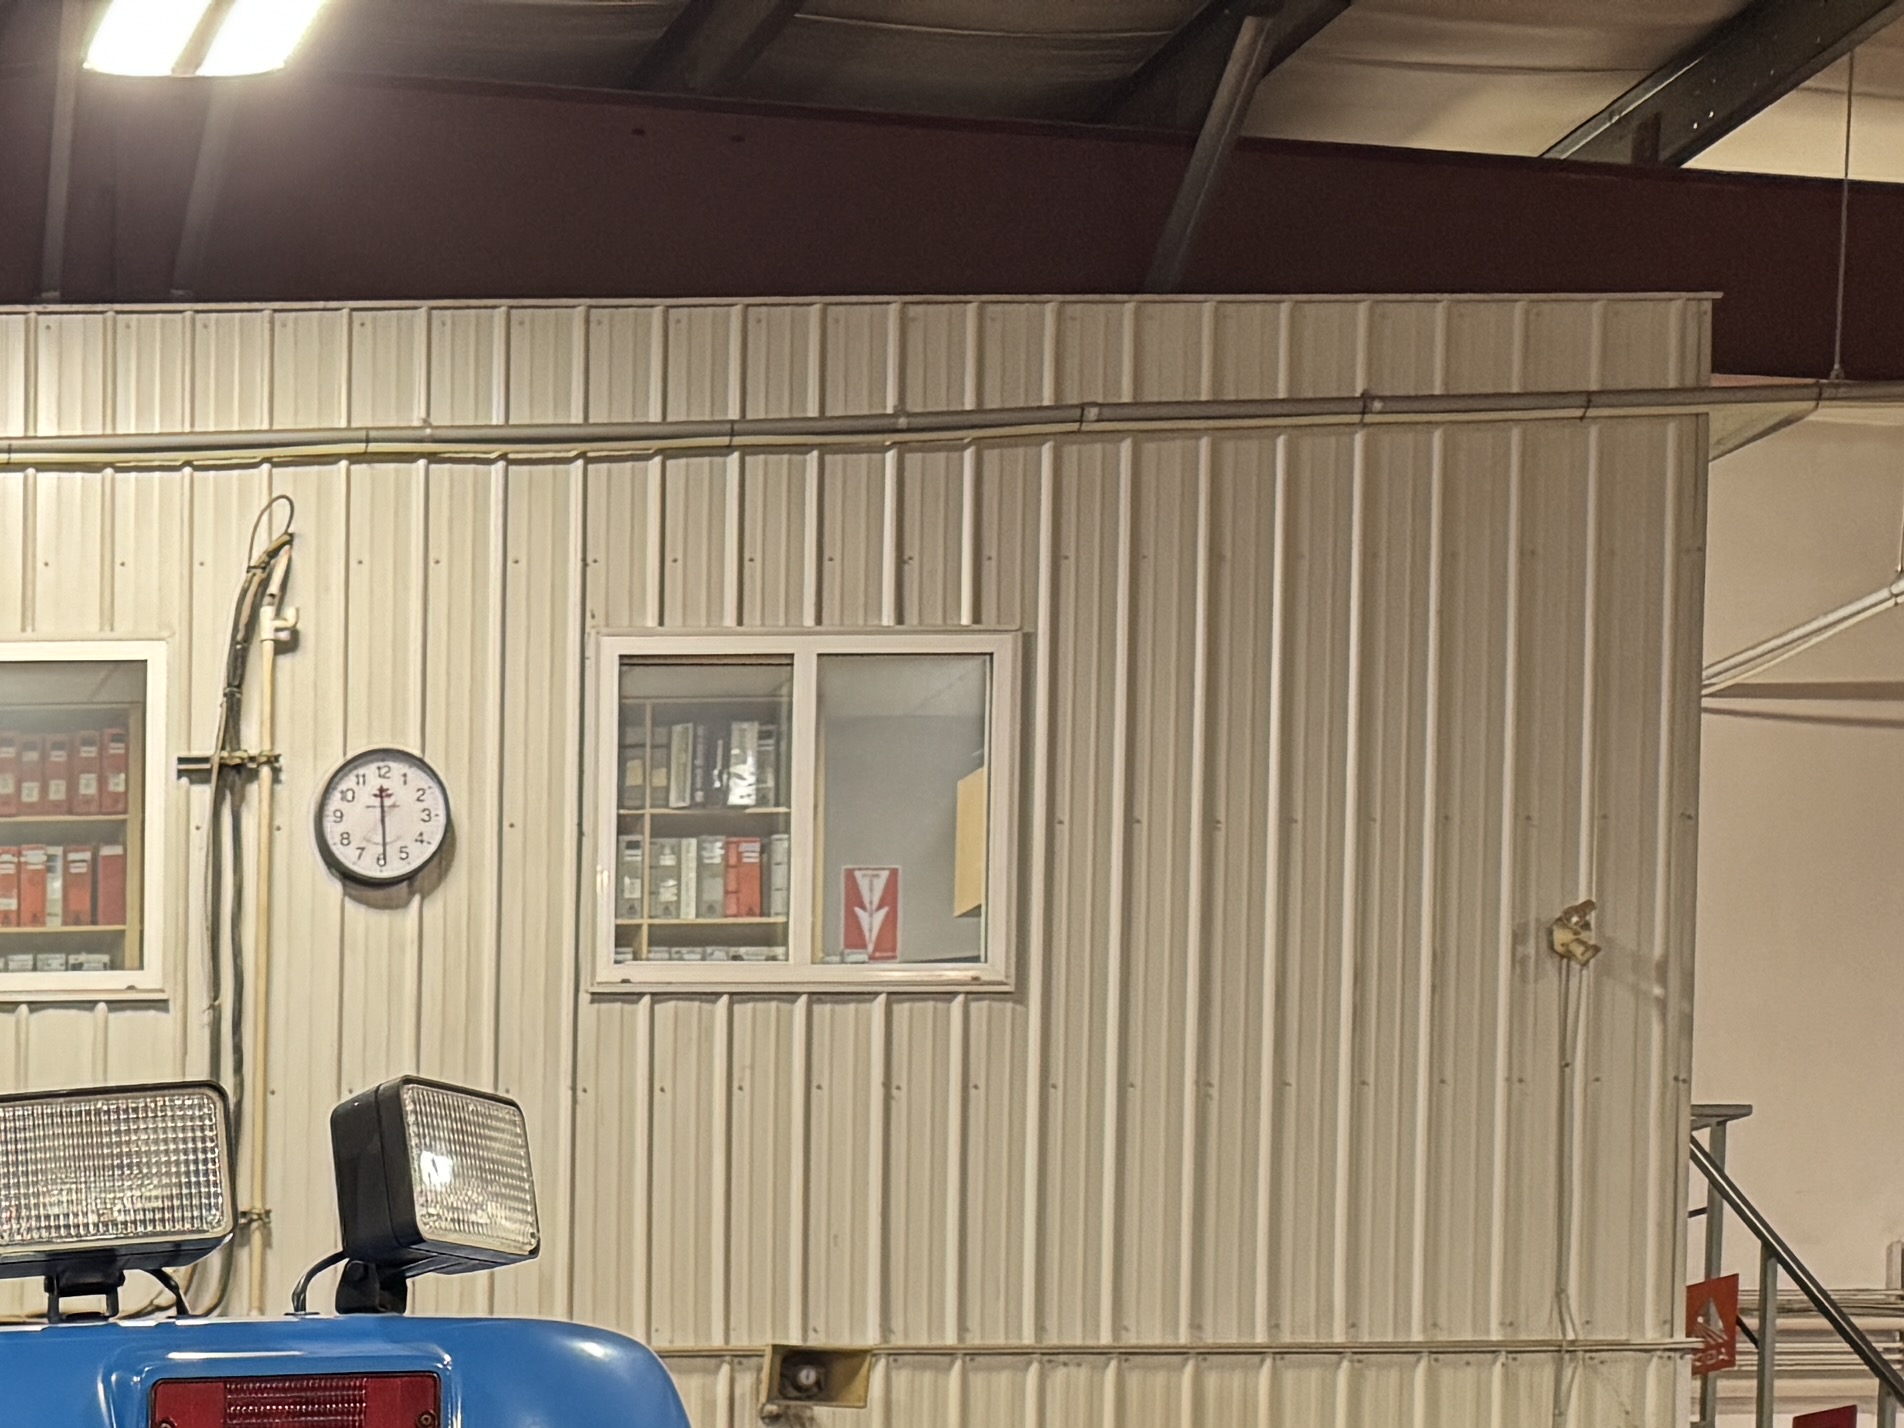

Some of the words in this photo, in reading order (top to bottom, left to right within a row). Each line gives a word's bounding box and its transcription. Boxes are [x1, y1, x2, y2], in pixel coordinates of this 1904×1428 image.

[376, 765, 391, 779] 12
[401, 772, 408, 785] 1
[355, 773, 366, 786] 11
[340, 788, 355, 803] 10
[416, 788, 426, 802] 2
[333, 809, 344, 823] 9
[420, 808, 432, 823] 3
[340, 831, 351, 846] 8
[414, 831, 425, 845] 4
[355, 847, 366, 860] 7
[399, 846, 409, 860] 5
